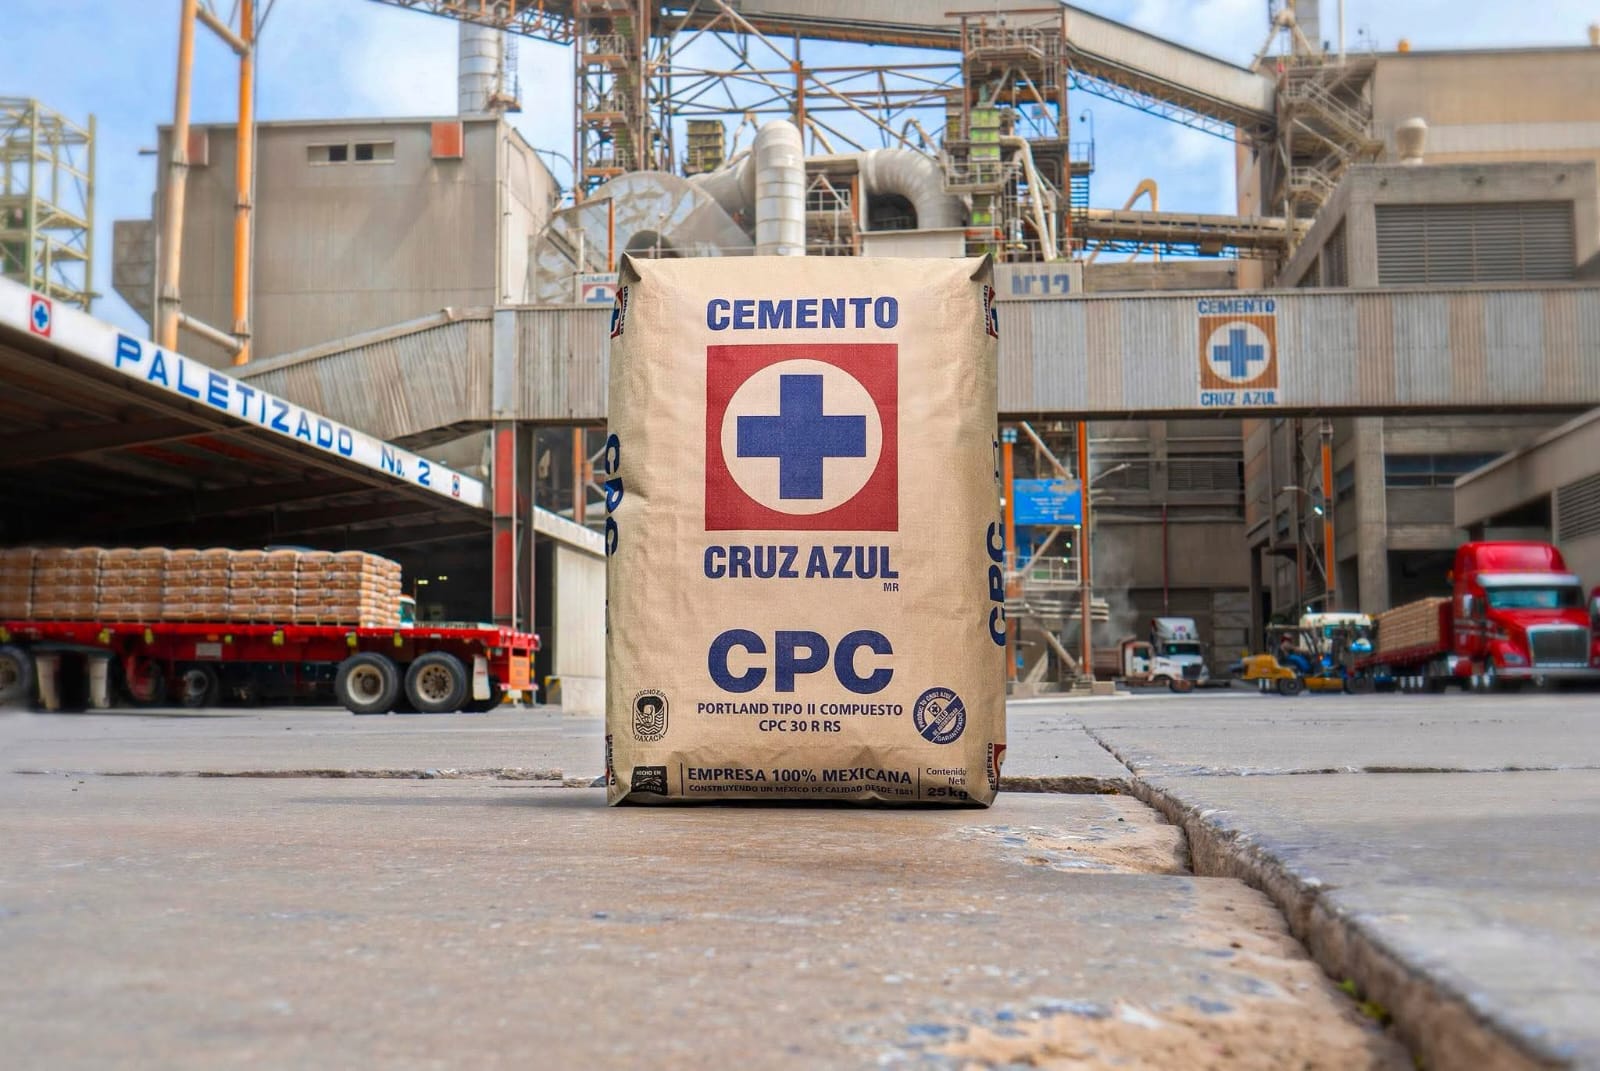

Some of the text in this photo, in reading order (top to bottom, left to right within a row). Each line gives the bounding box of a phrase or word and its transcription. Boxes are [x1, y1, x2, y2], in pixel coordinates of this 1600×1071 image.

[706, 296, 899, 331] CEMENTO
[1198, 299, 1275, 314] CEMENTO
[1201, 391, 1277, 406] CRUZ AZUL
[114, 333, 353, 457] PALETIZADO
[418, 460, 431, 486] 2
[605, 434, 624, 557] CPC
[704, 546, 899, 579] CRUZ AZUL
[883, 583, 899, 592] MR
[986, 521, 1006, 646] CPC
[708, 628, 894, 694] CPC
[697, 702, 903, 716] PORTLAND TIPO II COMPUESTO
[759, 720, 841, 732] CPC 30 R RS
[634, 734, 665, 743] OAXACA
[926, 767, 967, 776] Contenido
[986, 742, 996, 791] CEMENTO
[688, 767, 912, 784] EMPRESA 100% MEXICANA
[689, 784, 759, 793] CONSTRUYENDO
[825, 785, 863, 793] CALIDAD
[865, 784, 892, 793] DESDE
[927, 787, 968, 800] 25 kg
